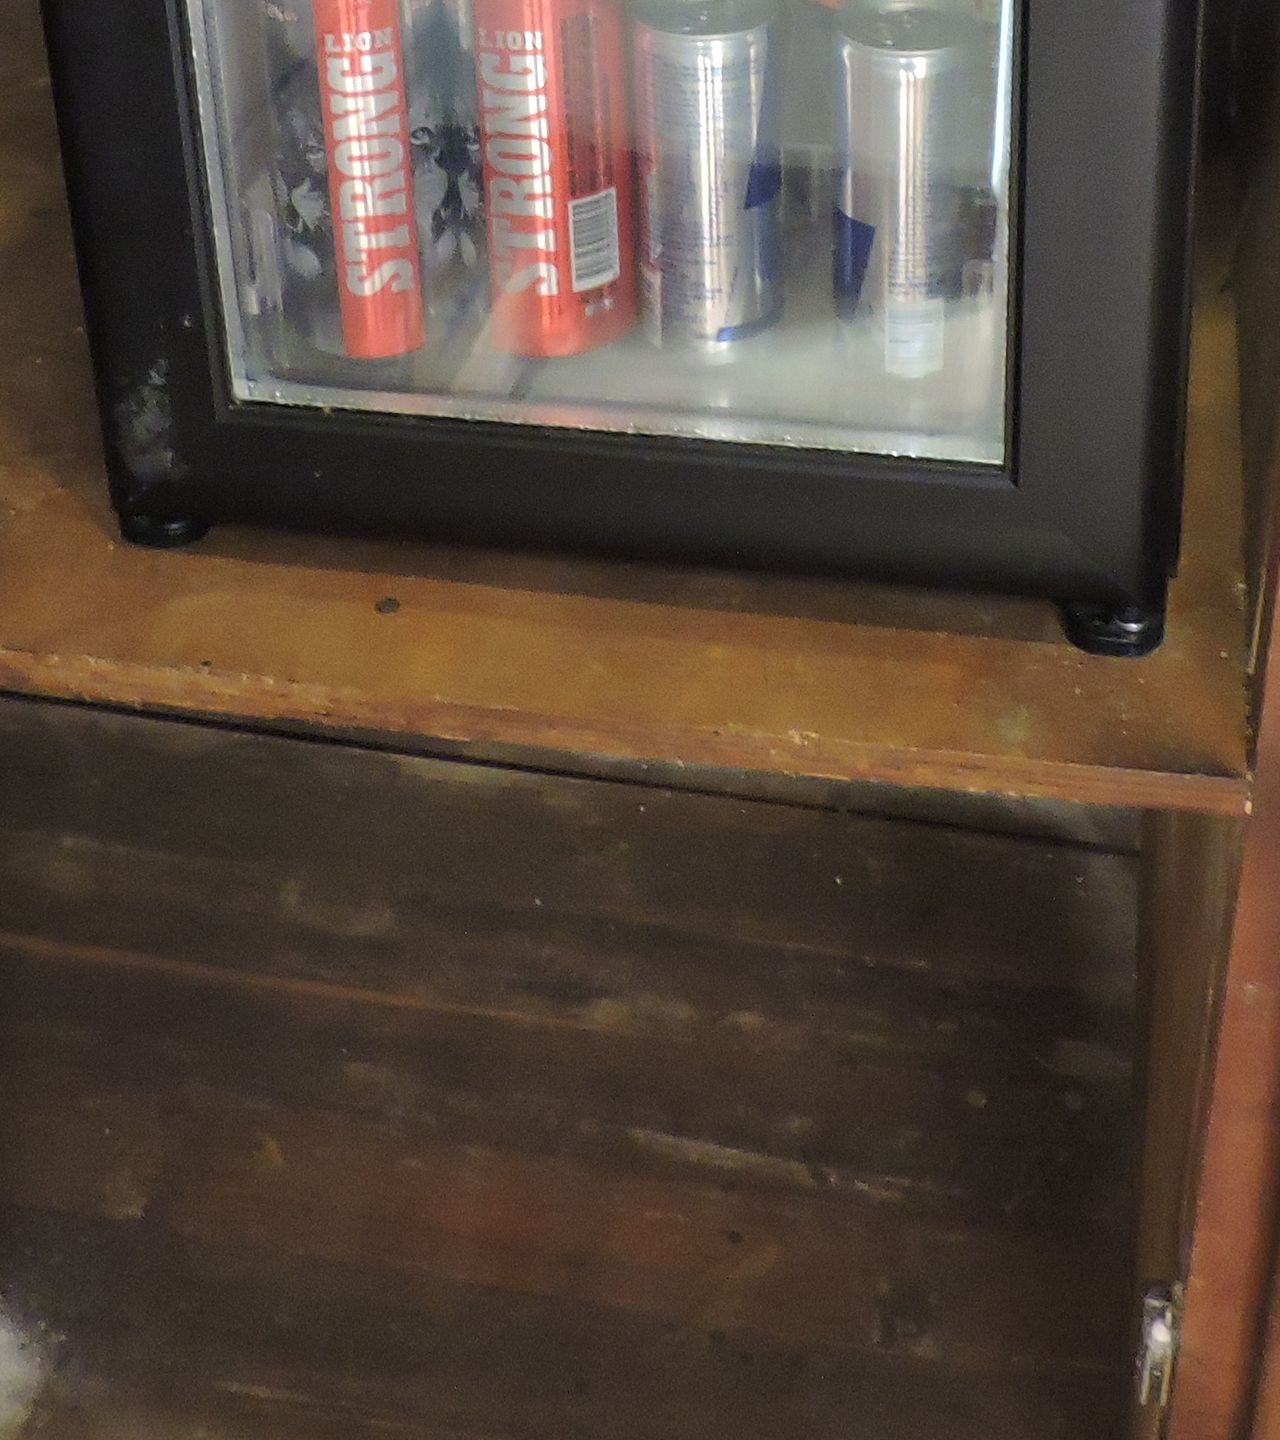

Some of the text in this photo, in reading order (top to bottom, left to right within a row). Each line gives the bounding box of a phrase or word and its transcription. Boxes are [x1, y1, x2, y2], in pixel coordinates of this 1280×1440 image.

[324, 27, 393, 52] LION
[478, 29, 544, 51] LION
[326, 50, 415, 298] STRONG
[479, 53, 560, 297] STRONG
